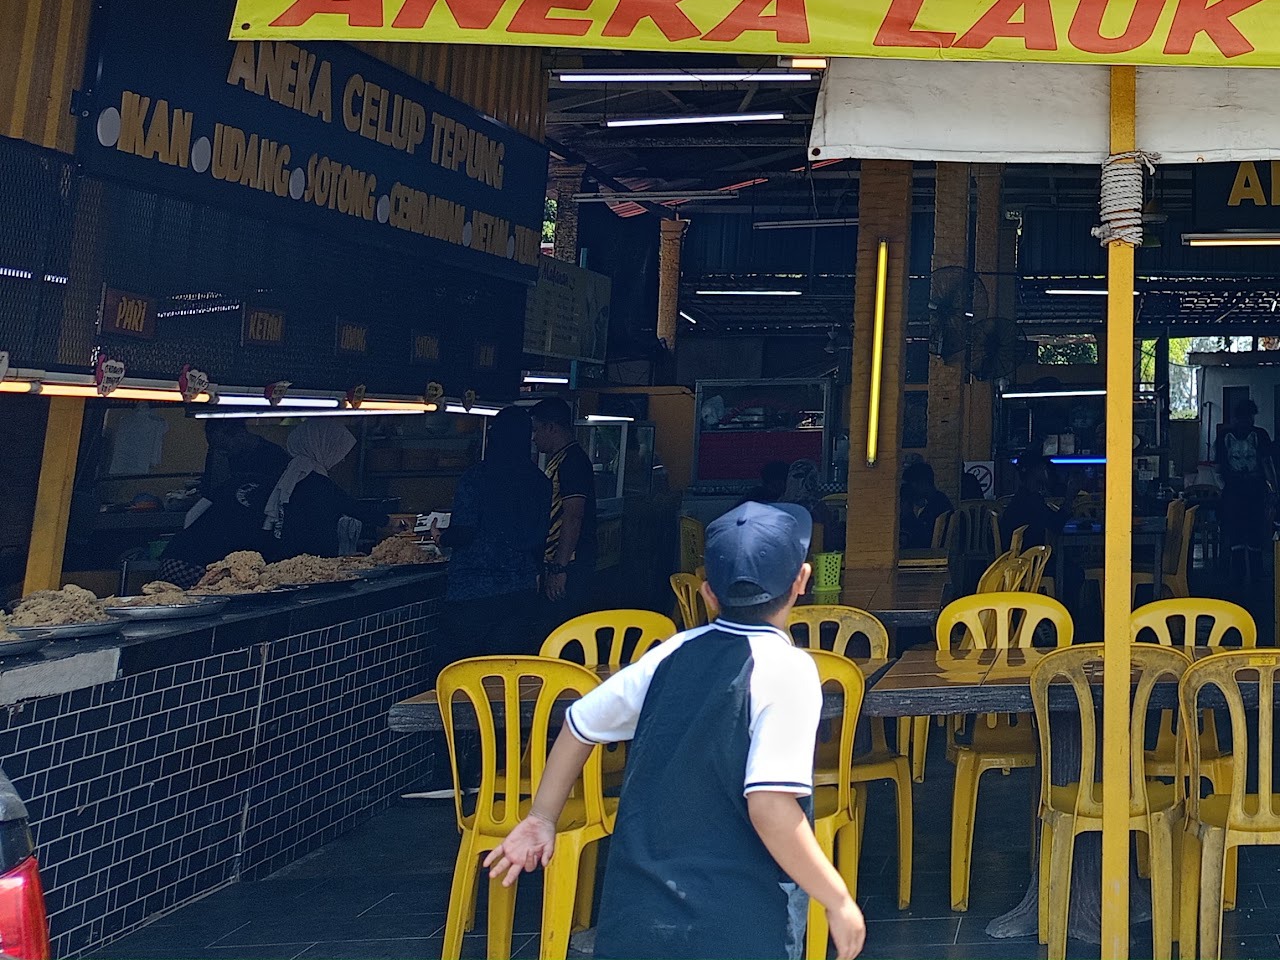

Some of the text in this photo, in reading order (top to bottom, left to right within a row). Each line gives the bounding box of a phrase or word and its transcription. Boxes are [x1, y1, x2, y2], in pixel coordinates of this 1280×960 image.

[117, 90, 193, 168] IKAN
[211, 123, 291, 197] UDANG
[305, 152, 377, 221] SOTONG
[227, 41, 505, 190] ANEKA CELUP TEPUNG
[116, 296, 147, 332] PARI
